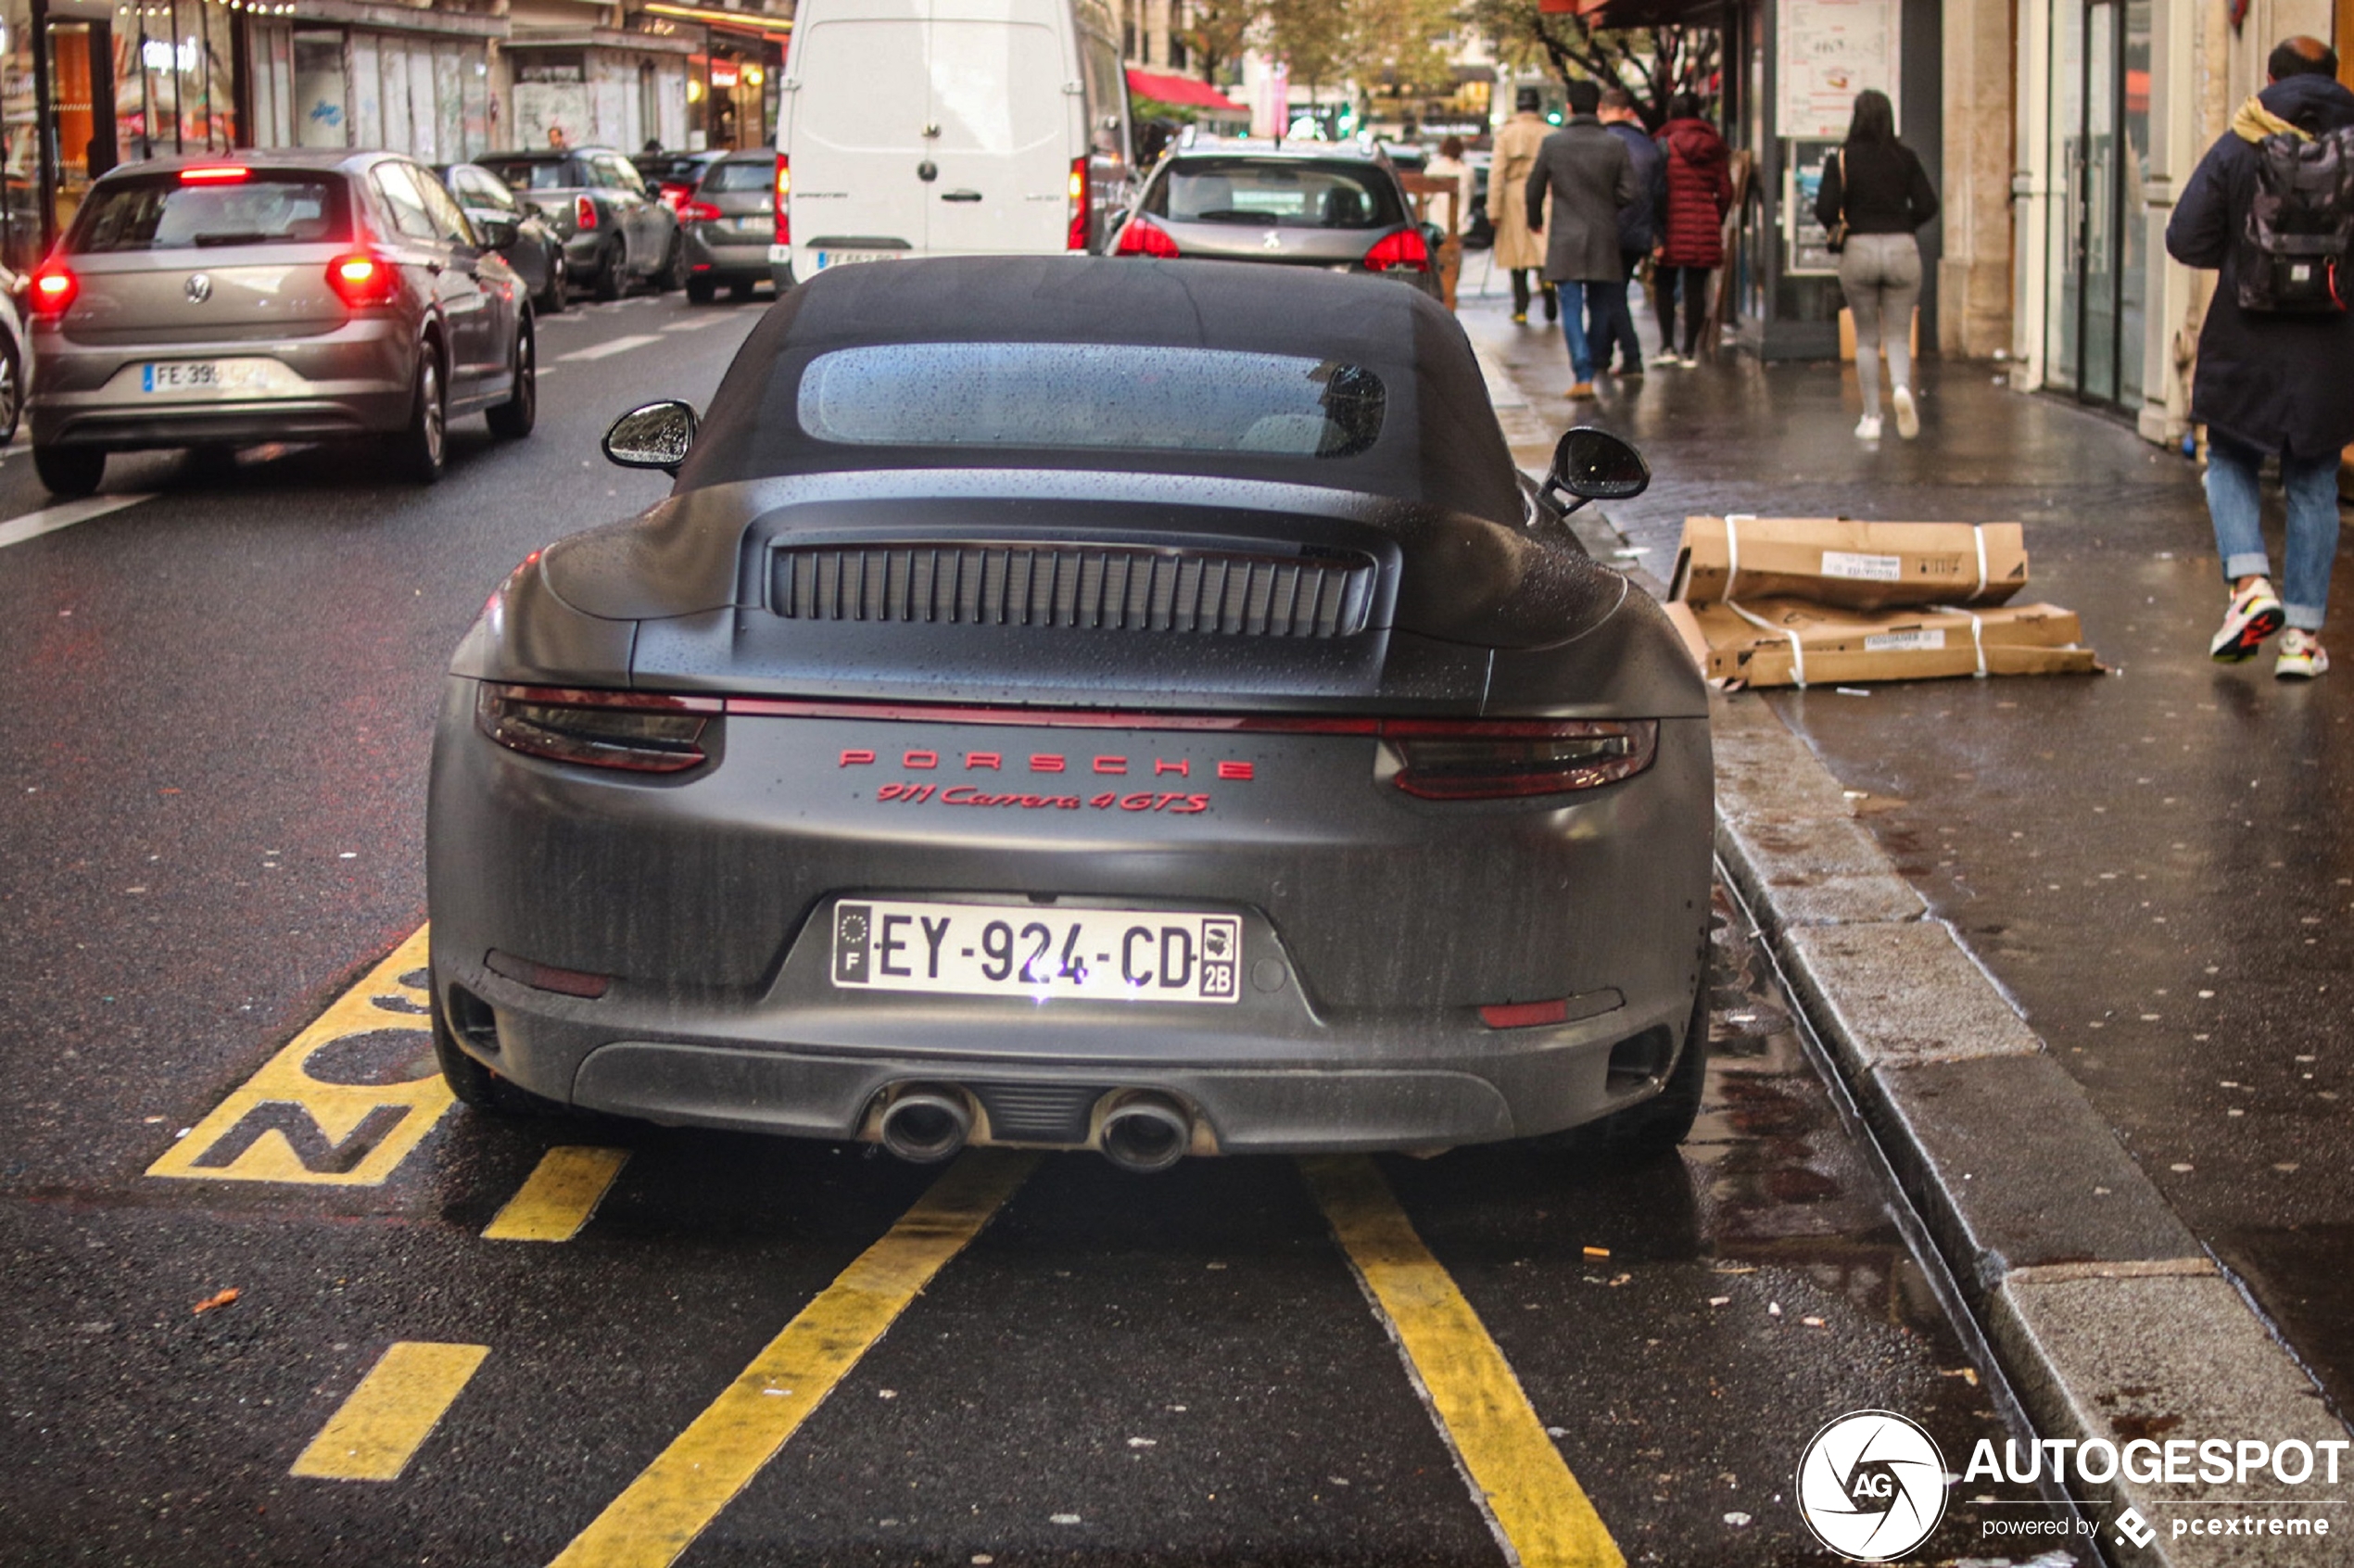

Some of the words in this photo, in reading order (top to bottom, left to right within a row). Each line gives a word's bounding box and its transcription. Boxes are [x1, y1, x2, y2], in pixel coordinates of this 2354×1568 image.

[839, 749, 1254, 780] PORSCHE
[877, 783, 937, 804] 911
[941, 785, 1081, 809] Carrera
[1090, 792, 1117, 809] 4
[1120, 792, 1210, 813] GTS
[844, 953, 860, 971] F
[880, 915, 1192, 989] EY-924-CD
[1203, 967, 1232, 993] 2B
